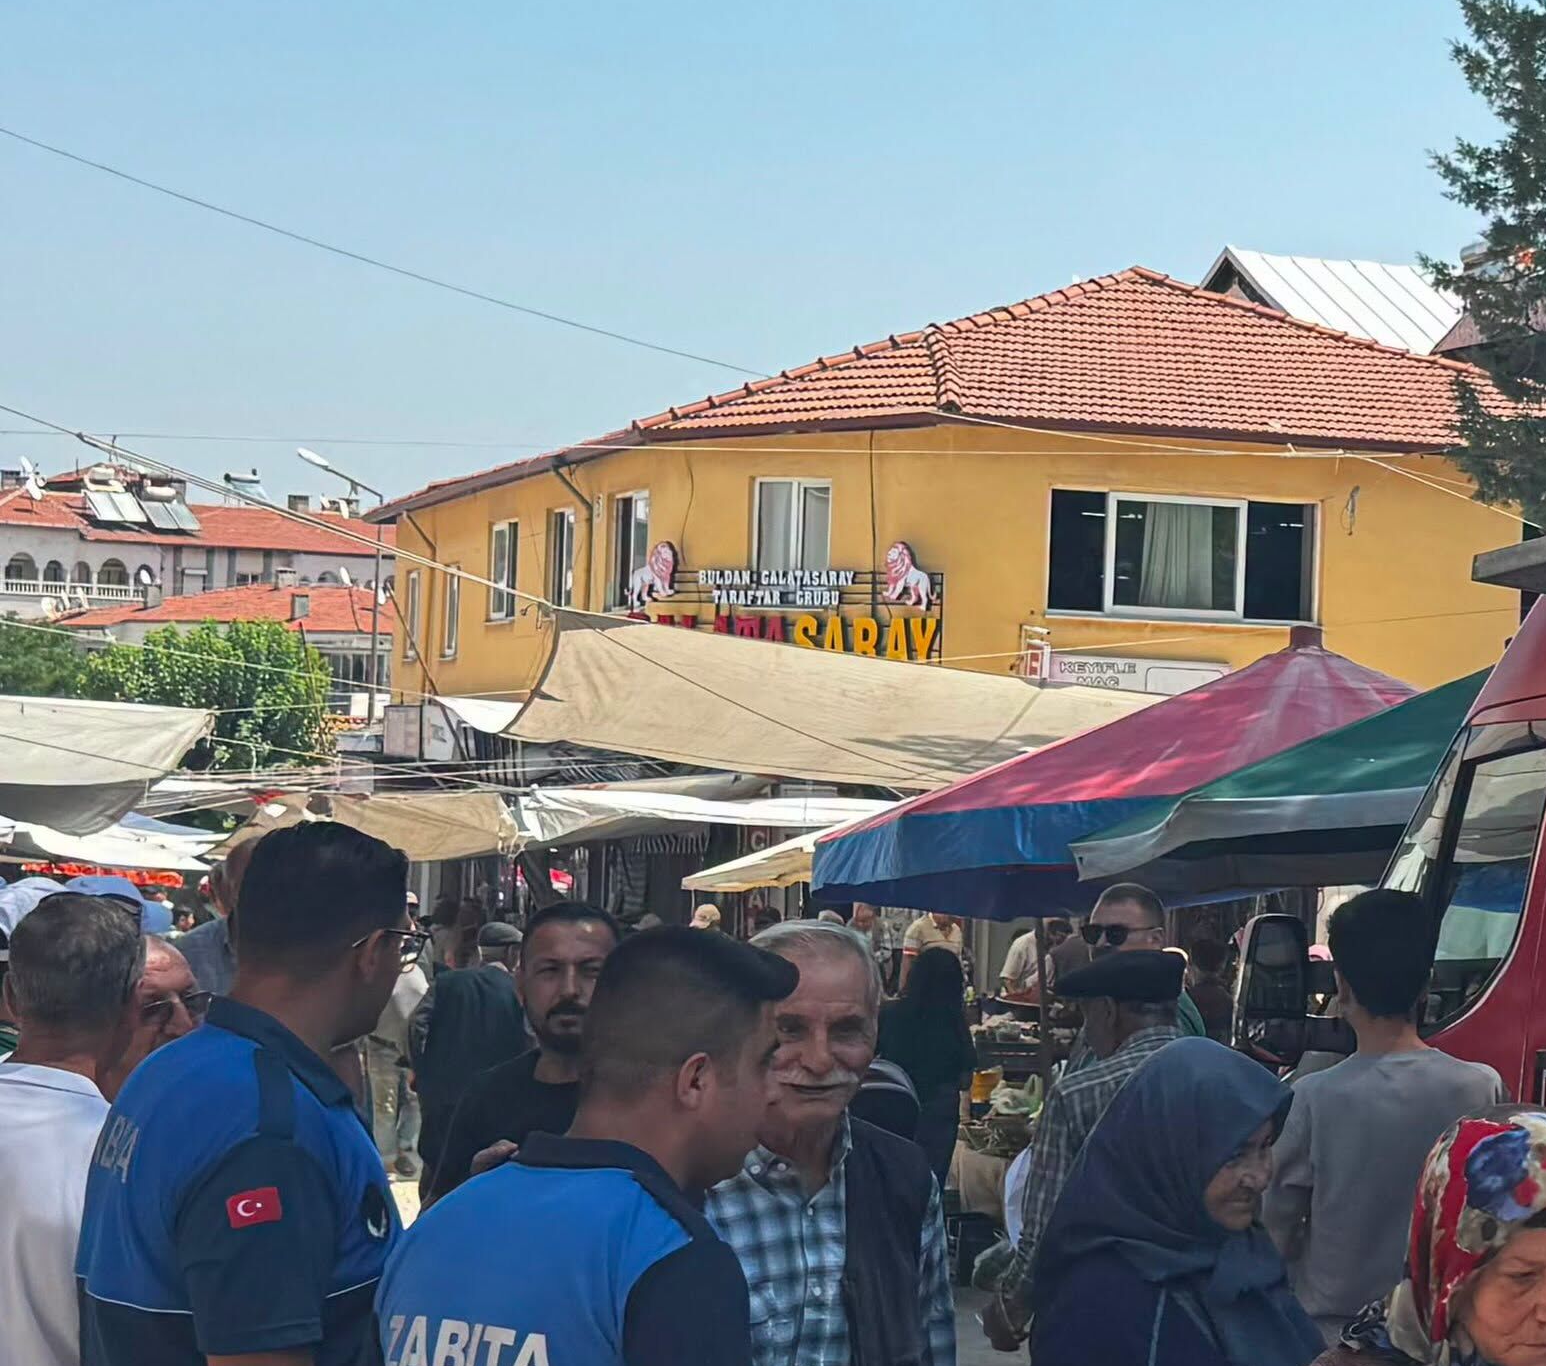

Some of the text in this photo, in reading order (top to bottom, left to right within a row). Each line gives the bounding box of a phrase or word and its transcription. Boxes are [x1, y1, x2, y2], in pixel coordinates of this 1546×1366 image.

[699, 569, 855, 586] BULDAN GALATASARAY
[712, 589, 840, 606] TARAFTAR GRUBU
